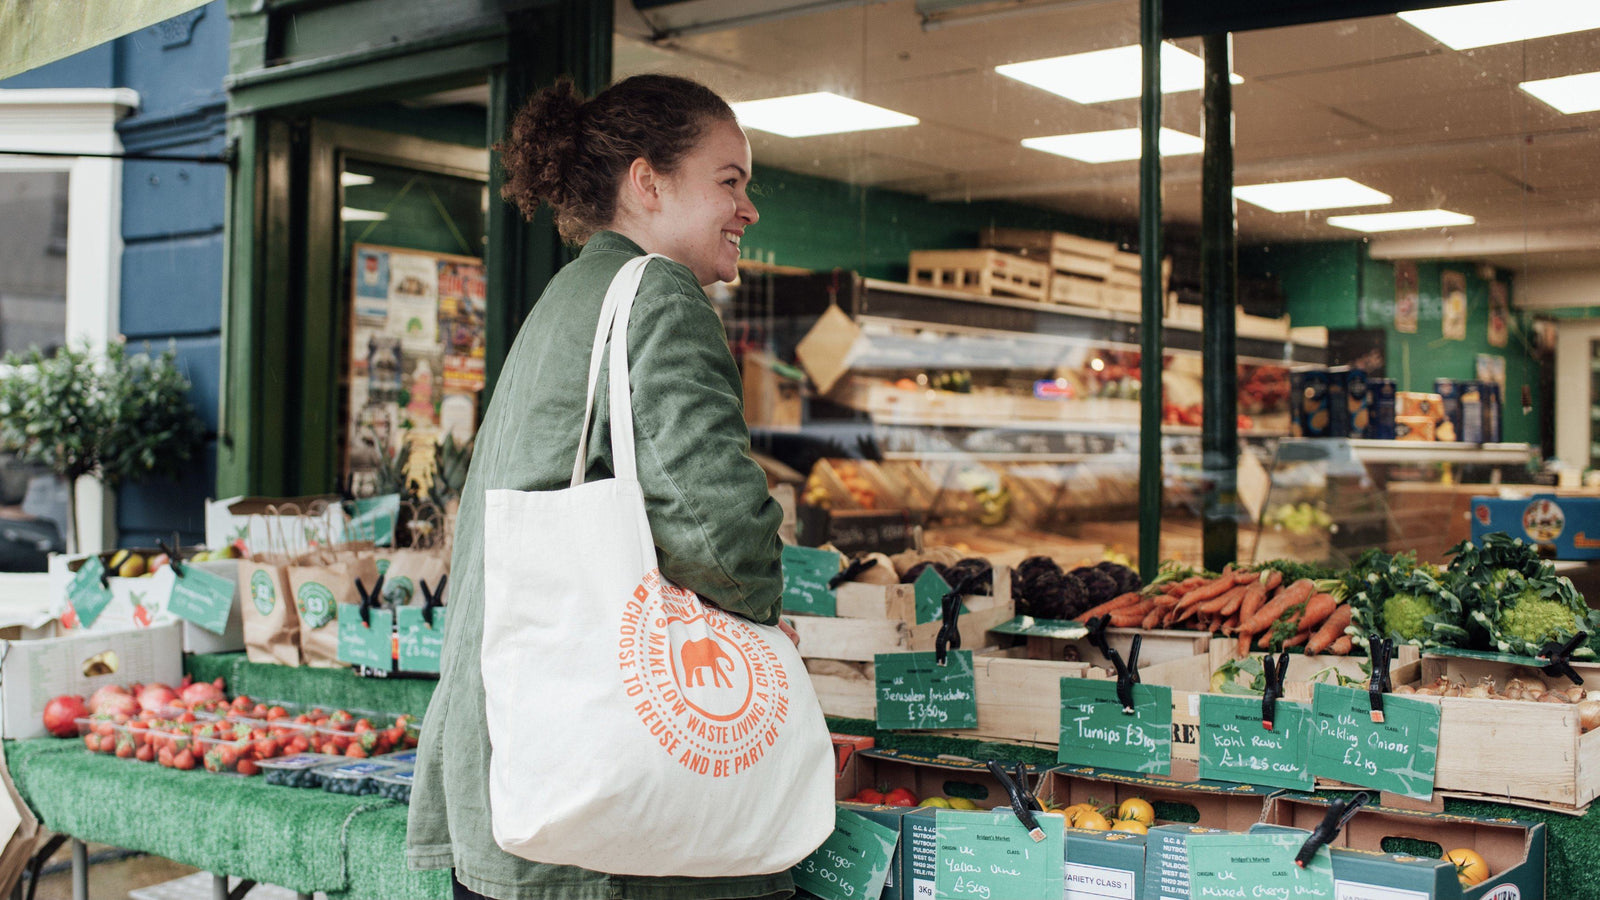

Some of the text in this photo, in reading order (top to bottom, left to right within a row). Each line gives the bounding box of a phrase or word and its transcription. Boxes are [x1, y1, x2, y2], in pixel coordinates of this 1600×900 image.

[619, 601, 789, 778] CHOOSE TO REUSE AND BE PART OF THE SOLUTION
[648, 631, 769, 744] MAKE LOW WASTE LIVING A CINCH
[1073, 716, 1120, 745] Turnips
[1320, 720, 1409, 754] Pickling Onions
[1213, 733, 1282, 749] Kohl Rabi
[825, 849, 856, 868] Tiger
[1024, 848, 1029, 859] 1
[945, 858, 981, 873] Yellow
[1294, 868, 1299, 879] 1
[918, 885, 932, 896] 3Kg
[1096, 878, 1122, 889] CLASS
[1202, 885, 1246, 898] Mixed
[1252, 885, 1290, 900] Cherry
